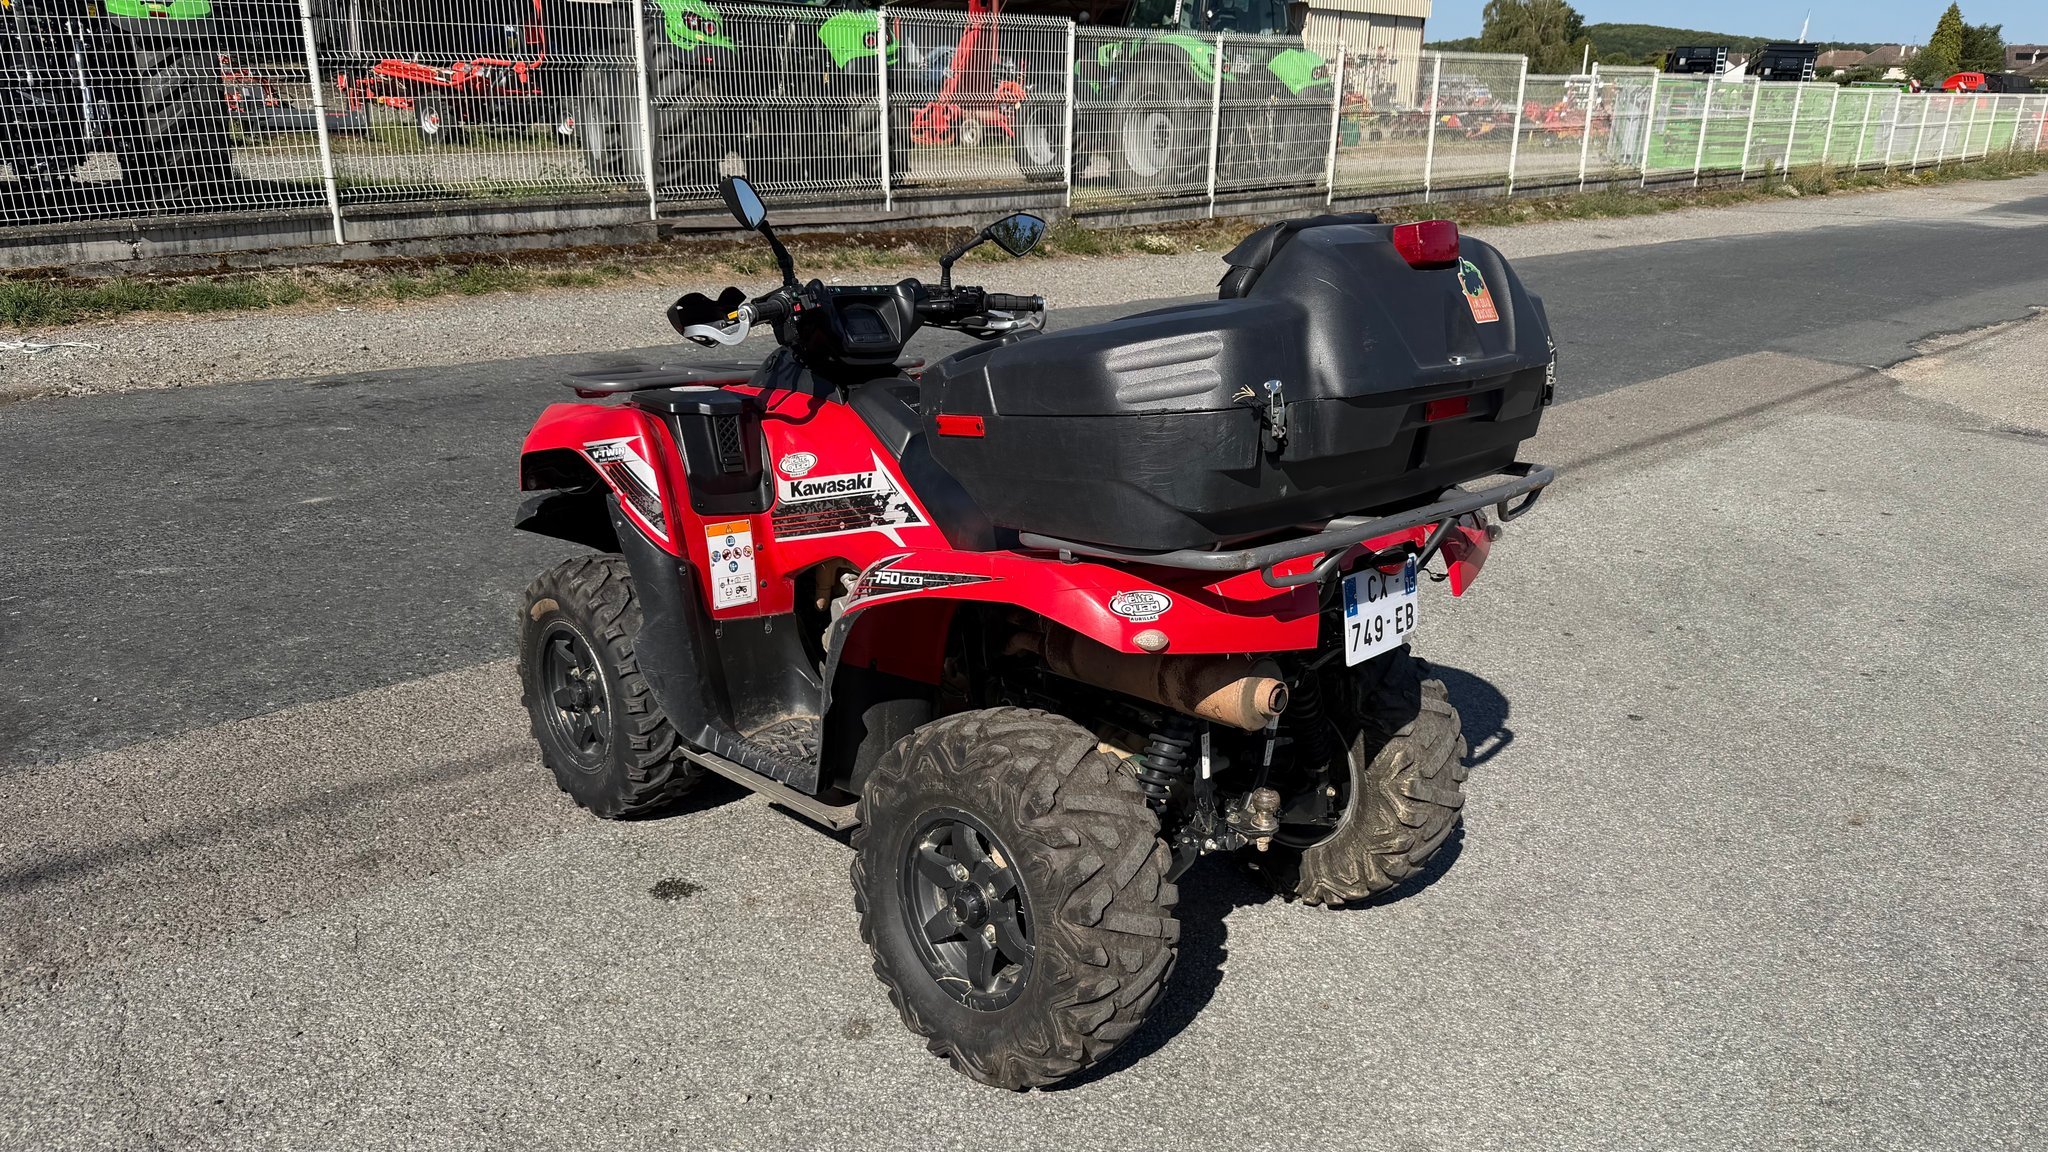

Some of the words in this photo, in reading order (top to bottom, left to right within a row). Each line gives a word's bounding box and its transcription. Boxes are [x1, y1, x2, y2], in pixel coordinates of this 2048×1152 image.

[592, 447, 625, 459] V-TWIN
[790, 473, 873, 498] Kawasaki
[874, 571, 900, 585] 750
[1351, 602, 1415, 652] 749-EB
